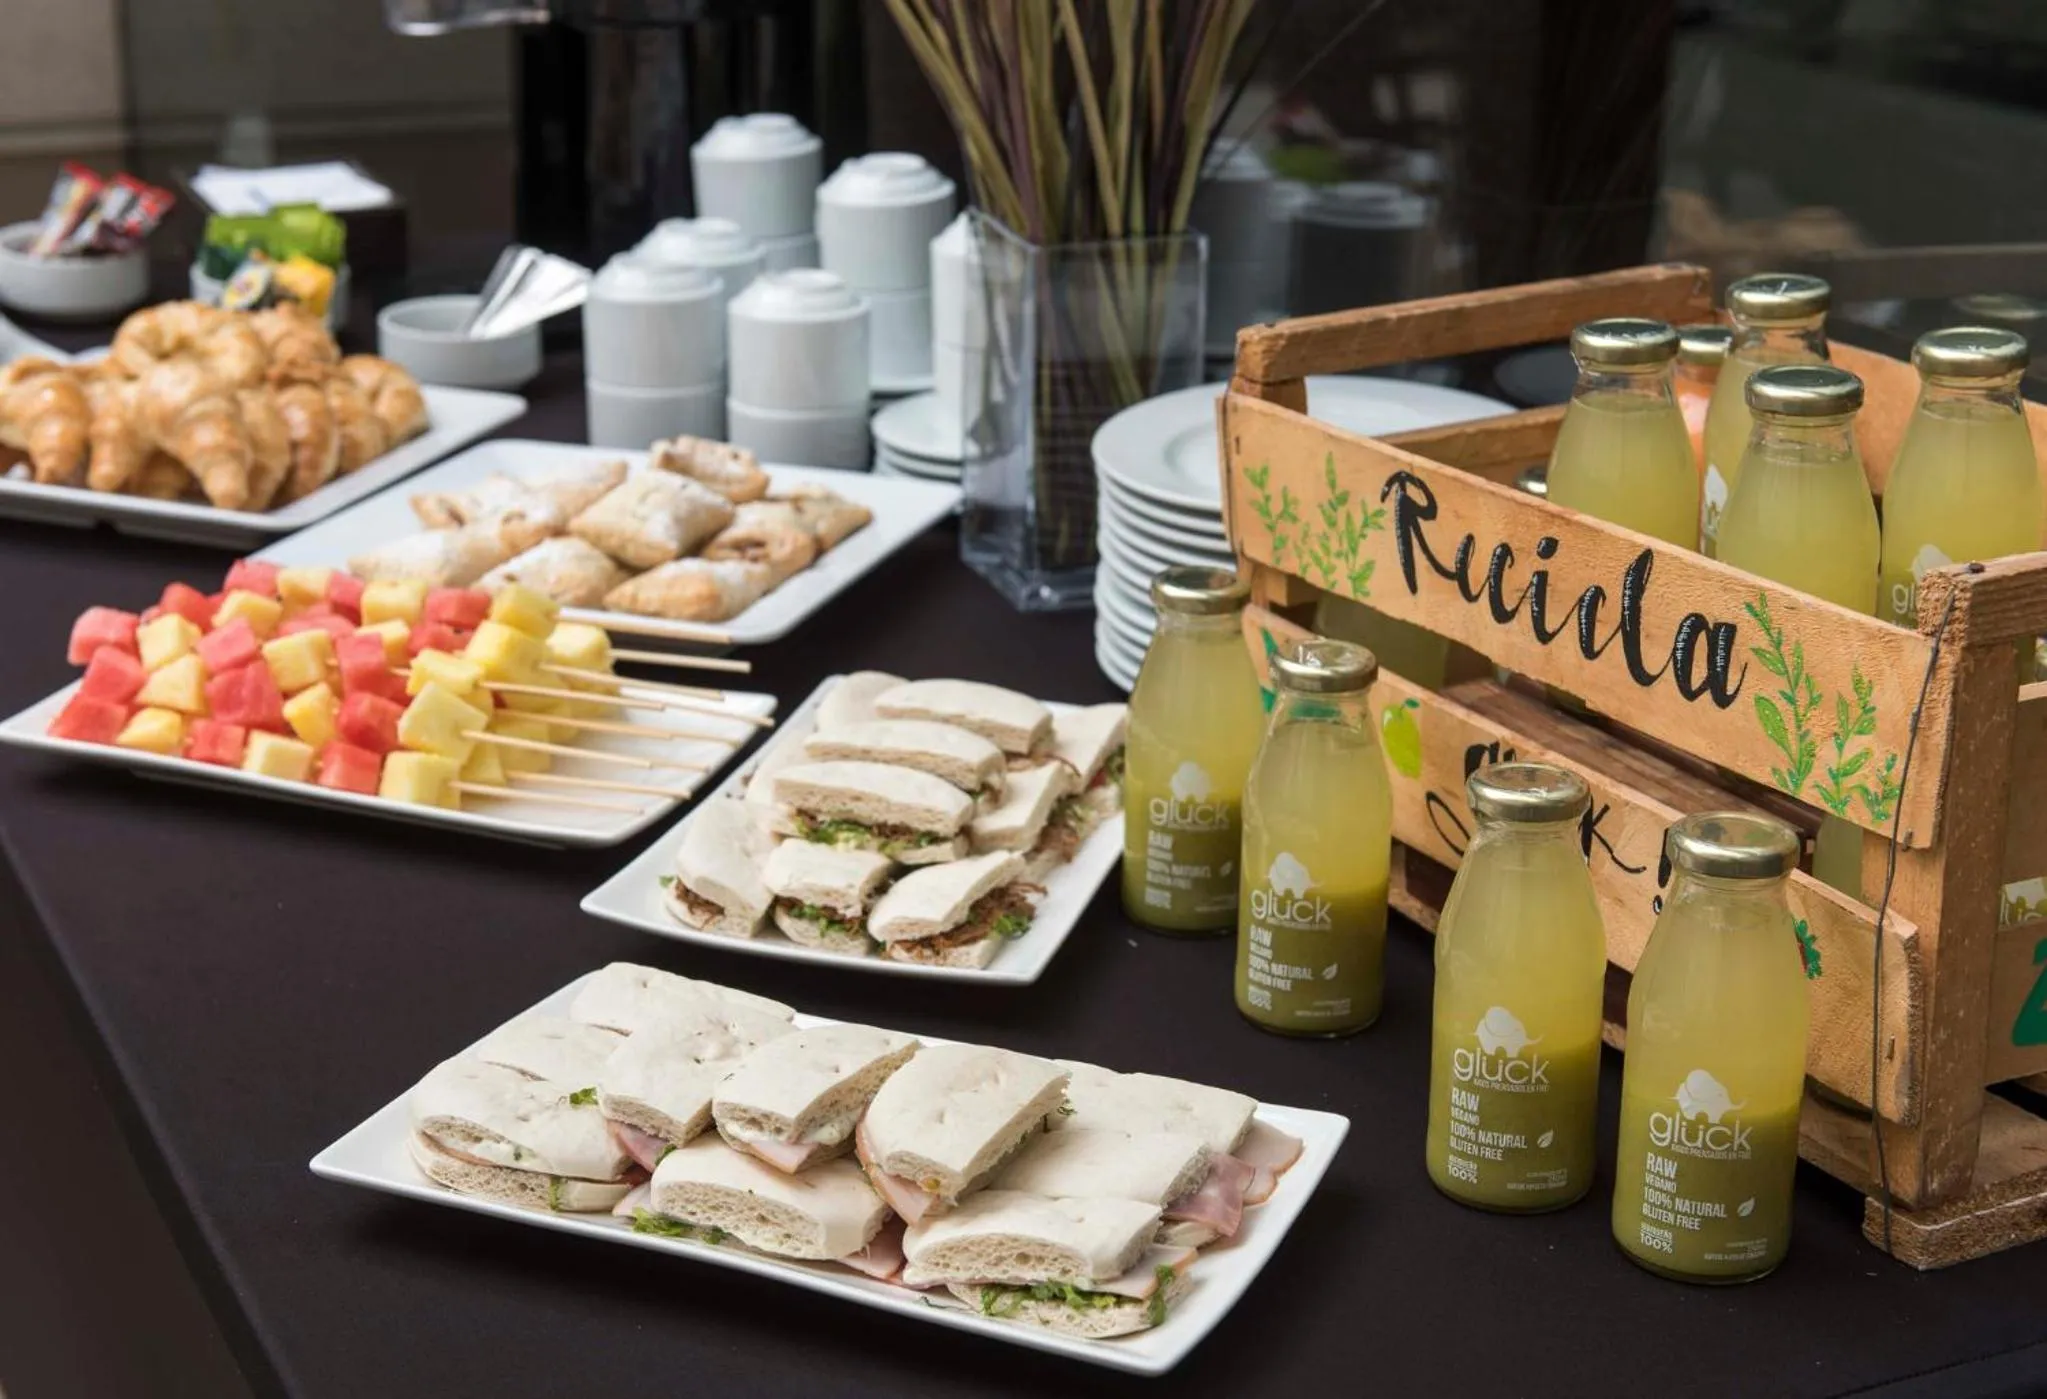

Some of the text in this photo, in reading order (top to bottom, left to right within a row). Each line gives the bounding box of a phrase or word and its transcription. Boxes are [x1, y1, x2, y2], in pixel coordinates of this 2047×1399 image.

[1380, 470, 1748, 709] Recicla
[1451, 1087, 1480, 1112] RAW
[1450, 1120, 1528, 1149] 100% NATURAL
[1480, 1146, 1504, 1161] FREE
[1646, 1152, 1678, 1179] RAW
[1645, 1172, 1677, 1194] VEGANO
[1644, 1186, 1728, 1218] 100% NATURAL
[1642, 1203, 1701, 1231] GLUTEN FREE
[1640, 1233, 1673, 1254] 100%
